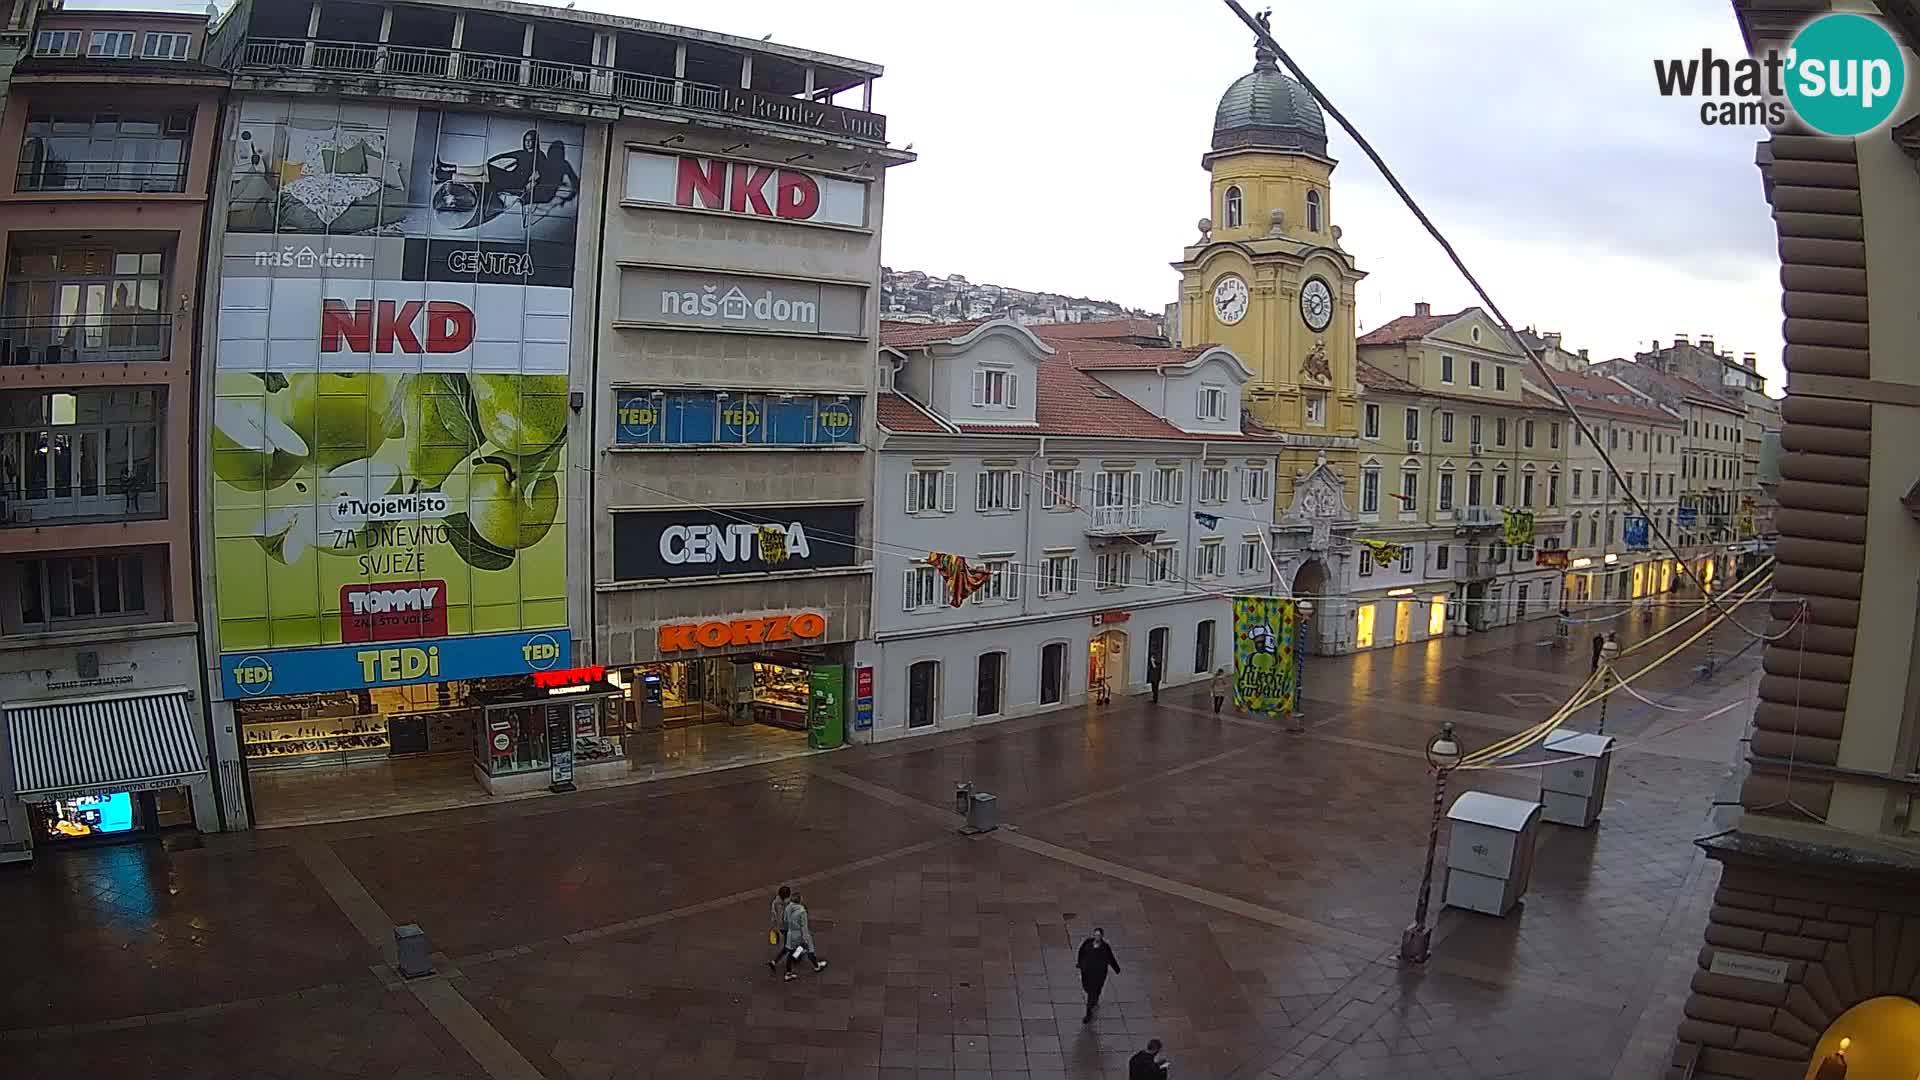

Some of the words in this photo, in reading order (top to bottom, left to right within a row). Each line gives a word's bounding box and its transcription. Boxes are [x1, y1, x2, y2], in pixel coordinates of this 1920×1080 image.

[722, 89, 745, 112] Le
[675, 158, 820, 219] NKD
[255, 246, 294, 266] naš
[319, 247, 365, 268] dom
[448, 250, 534, 275] CENTRA
[661, 280, 718, 316] naš
[754, 291, 816, 323] dom
[321, 298, 476, 353] NKD
[619, 408, 657, 425] TEDi
[724, 409, 759, 426] TEDi
[820, 411, 852, 427] TEDi
[338, 497, 446, 517] #TvojeMisto
[333, 529, 357, 549] ZA
[366, 524, 450, 548] DNEVNO
[359, 548, 426, 576] SVJEŽE
[348, 587, 439, 615] TOMMY
[659, 613, 825, 653] KORZO
[522, 642, 560, 661] TEDi
[234, 667, 273, 684] TEDi
[357, 646, 439, 682] TEDi
[533, 664, 605, 688] TOMMY
